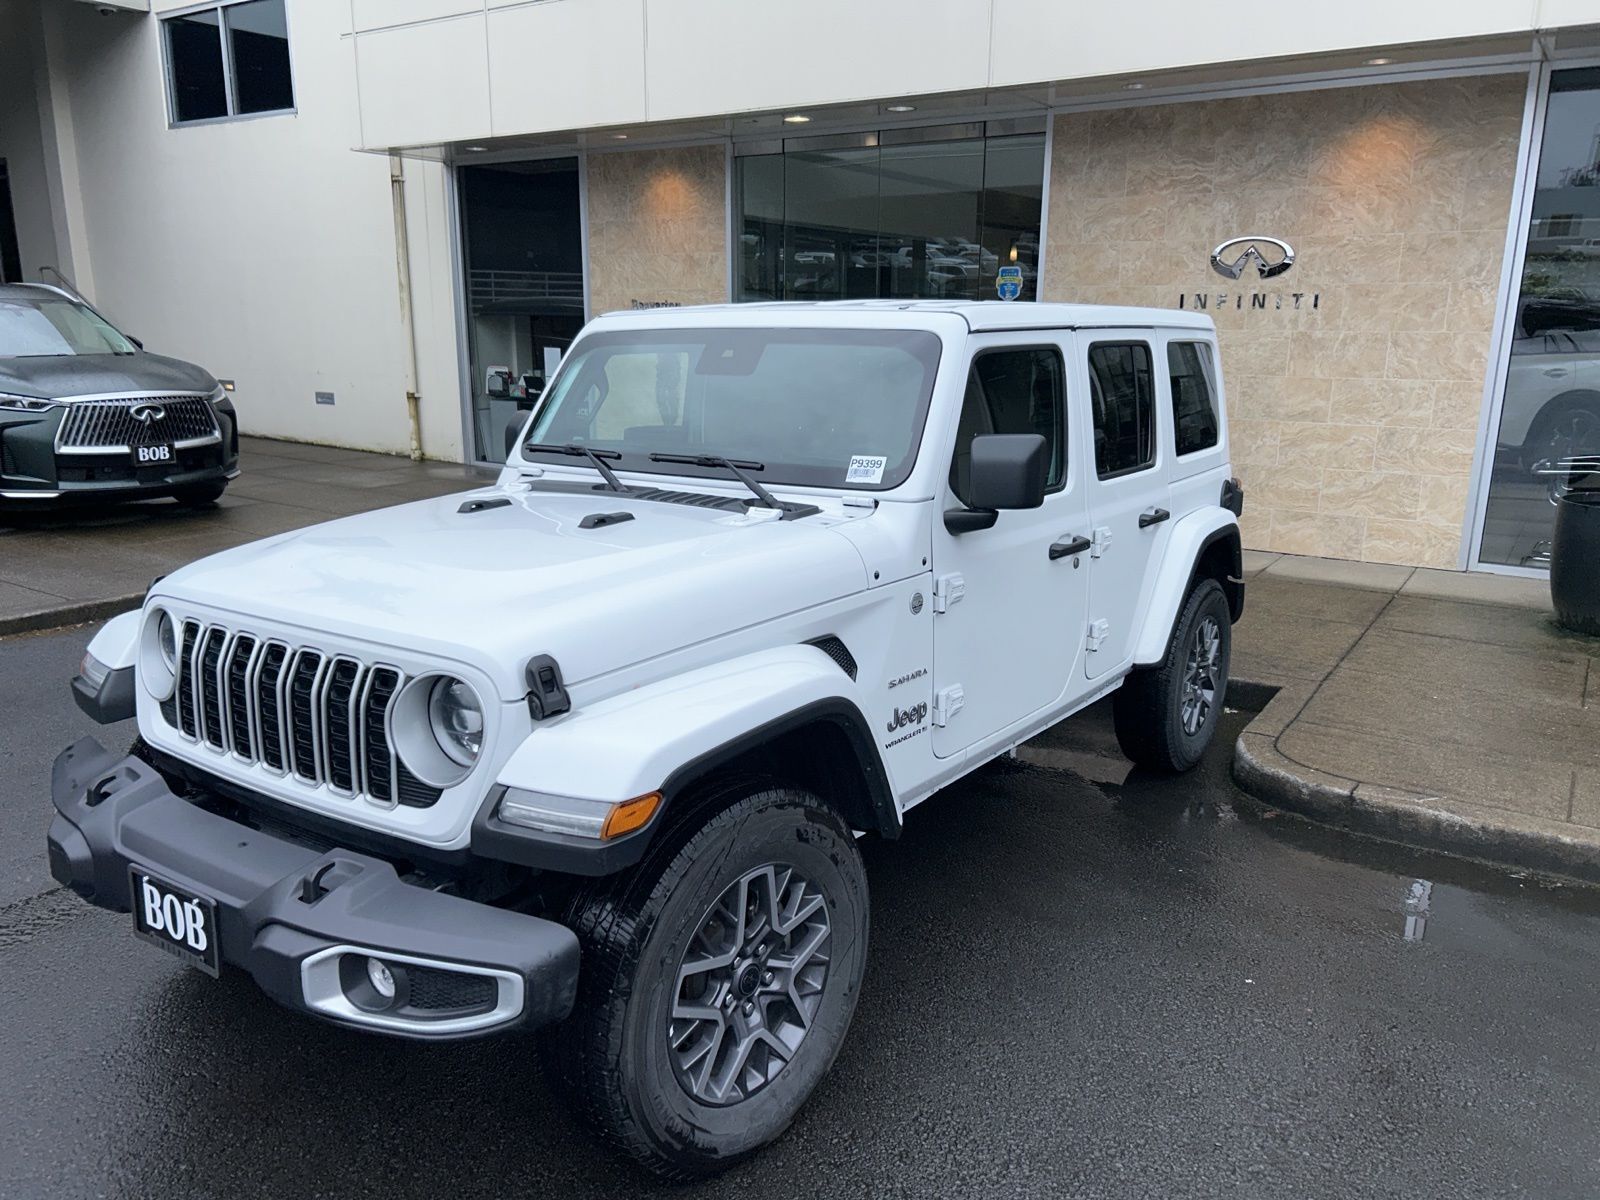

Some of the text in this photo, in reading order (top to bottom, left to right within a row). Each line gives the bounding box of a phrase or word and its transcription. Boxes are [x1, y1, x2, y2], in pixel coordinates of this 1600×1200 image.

[1179, 293, 1320, 310] INFINITI
[138, 446, 170, 461] BOB
[851, 458, 883, 469] P9399
[888, 668, 928, 689] SAHARA
[887, 701, 927, 732] Jeep
[885, 728, 921, 749] WRANGLER
[143, 882, 207, 951] BOB
